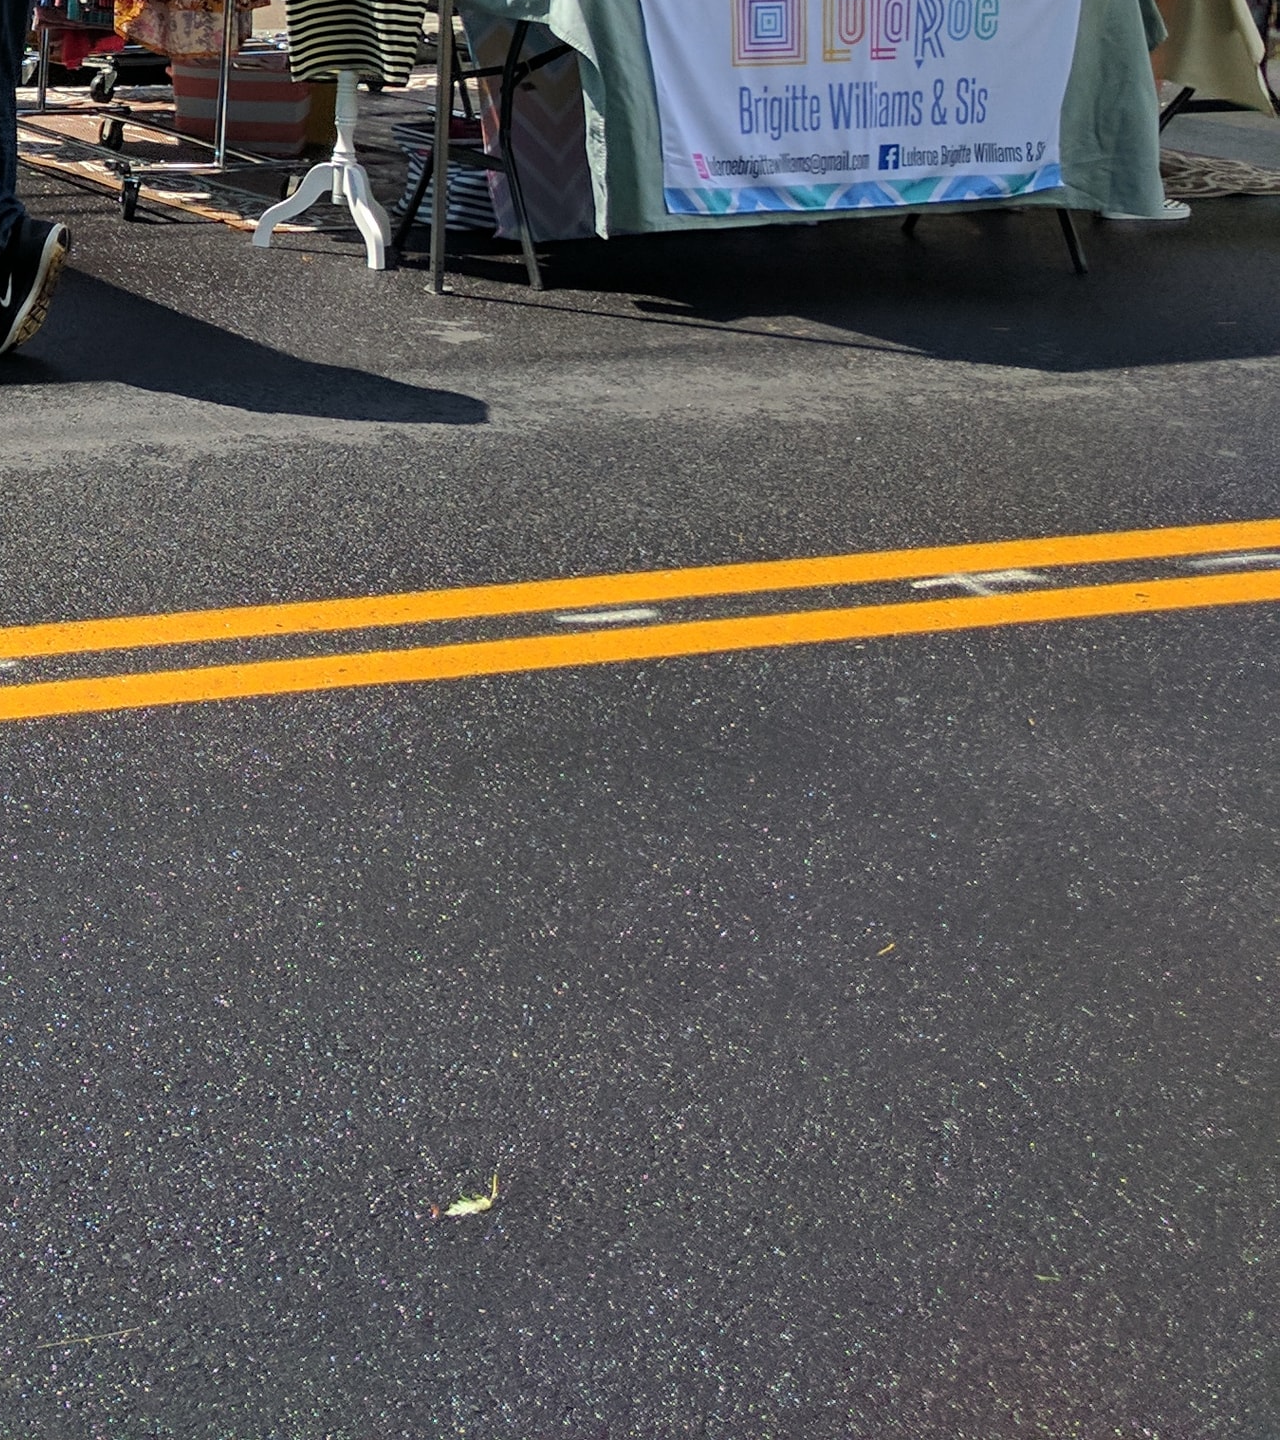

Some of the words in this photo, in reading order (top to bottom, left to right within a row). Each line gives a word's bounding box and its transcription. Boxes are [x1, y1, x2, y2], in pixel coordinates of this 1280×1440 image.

[740, 84, 821, 141] Brigitte
[828, 80, 923, 129] Williams
[931, 78, 947, 126] &
[956, 77, 989, 125] Sis
[901, 146, 938, 168] Lularoe
[940, 144, 971, 167] Brigitte
[974, 142, 1023, 163] Williams
[1025, 141, 1035, 162] &
